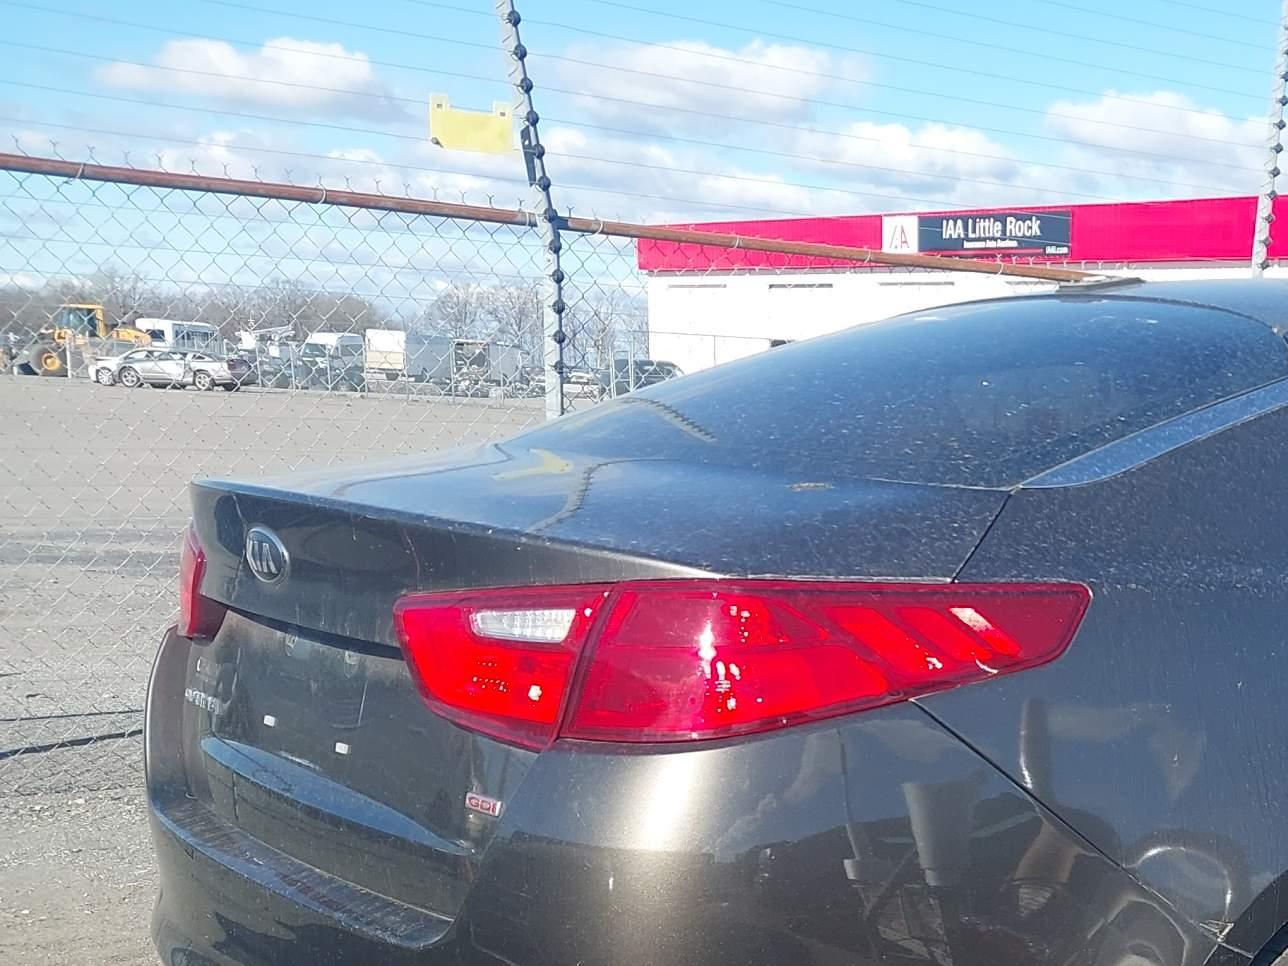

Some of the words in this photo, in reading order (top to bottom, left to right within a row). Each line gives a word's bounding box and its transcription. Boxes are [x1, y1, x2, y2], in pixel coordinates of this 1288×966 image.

[942, 219, 964, 239] IAA
[968, 217, 1002, 238] Little
[1006, 215, 1041, 237] Rock
[468, 795, 498, 815] GDI
